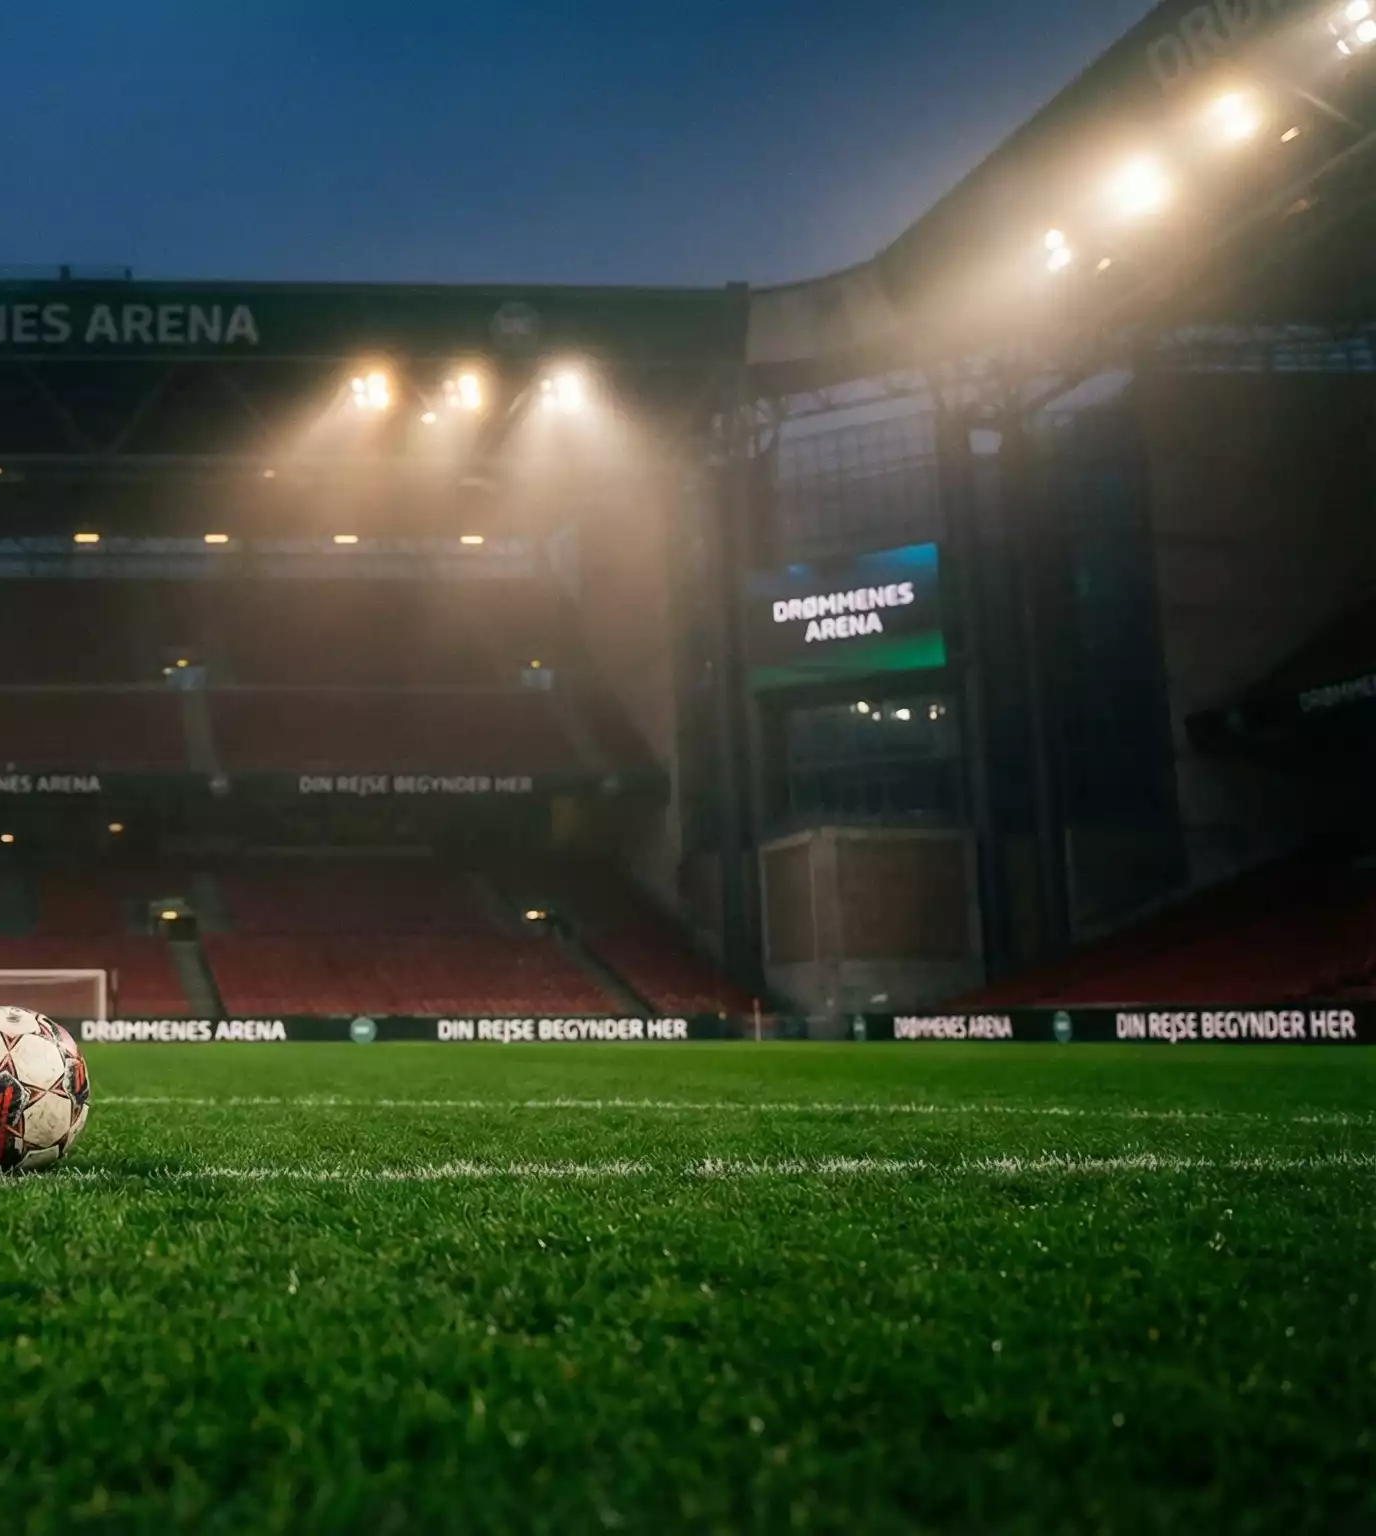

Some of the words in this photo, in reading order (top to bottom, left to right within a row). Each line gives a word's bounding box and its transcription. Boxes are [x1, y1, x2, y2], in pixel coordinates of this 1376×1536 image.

[84, 304, 260, 345] ARENA
[773, 581, 915, 622] DRØMMENES
[805, 611, 883, 643] ARENA
[36, 775, 101, 793] ARENA
[299, 775, 333, 794] DIN
[336, 775, 388, 797] REJSE
[393, 775, 491, 793] BEGYNDER
[495, 775, 532, 793] HER
[80, 1020, 212, 1042] DRØMMENES
[214, 1020, 286, 1041] ARENA
[437, 1019, 473, 1040] DIN
[477, 1018, 535, 1044] REJSE
[538, 1019, 644, 1040] BEGYNDER
[647, 1018, 688, 1040] HER
[968, 1015, 1013, 1039] ARENA
[1115, 1012, 1146, 1039] DIN
[1148, 1012, 1198, 1044] REJSE
[1200, 1010, 1306, 1039] BEGYNDER
[1309, 1009, 1356, 1039] HER
